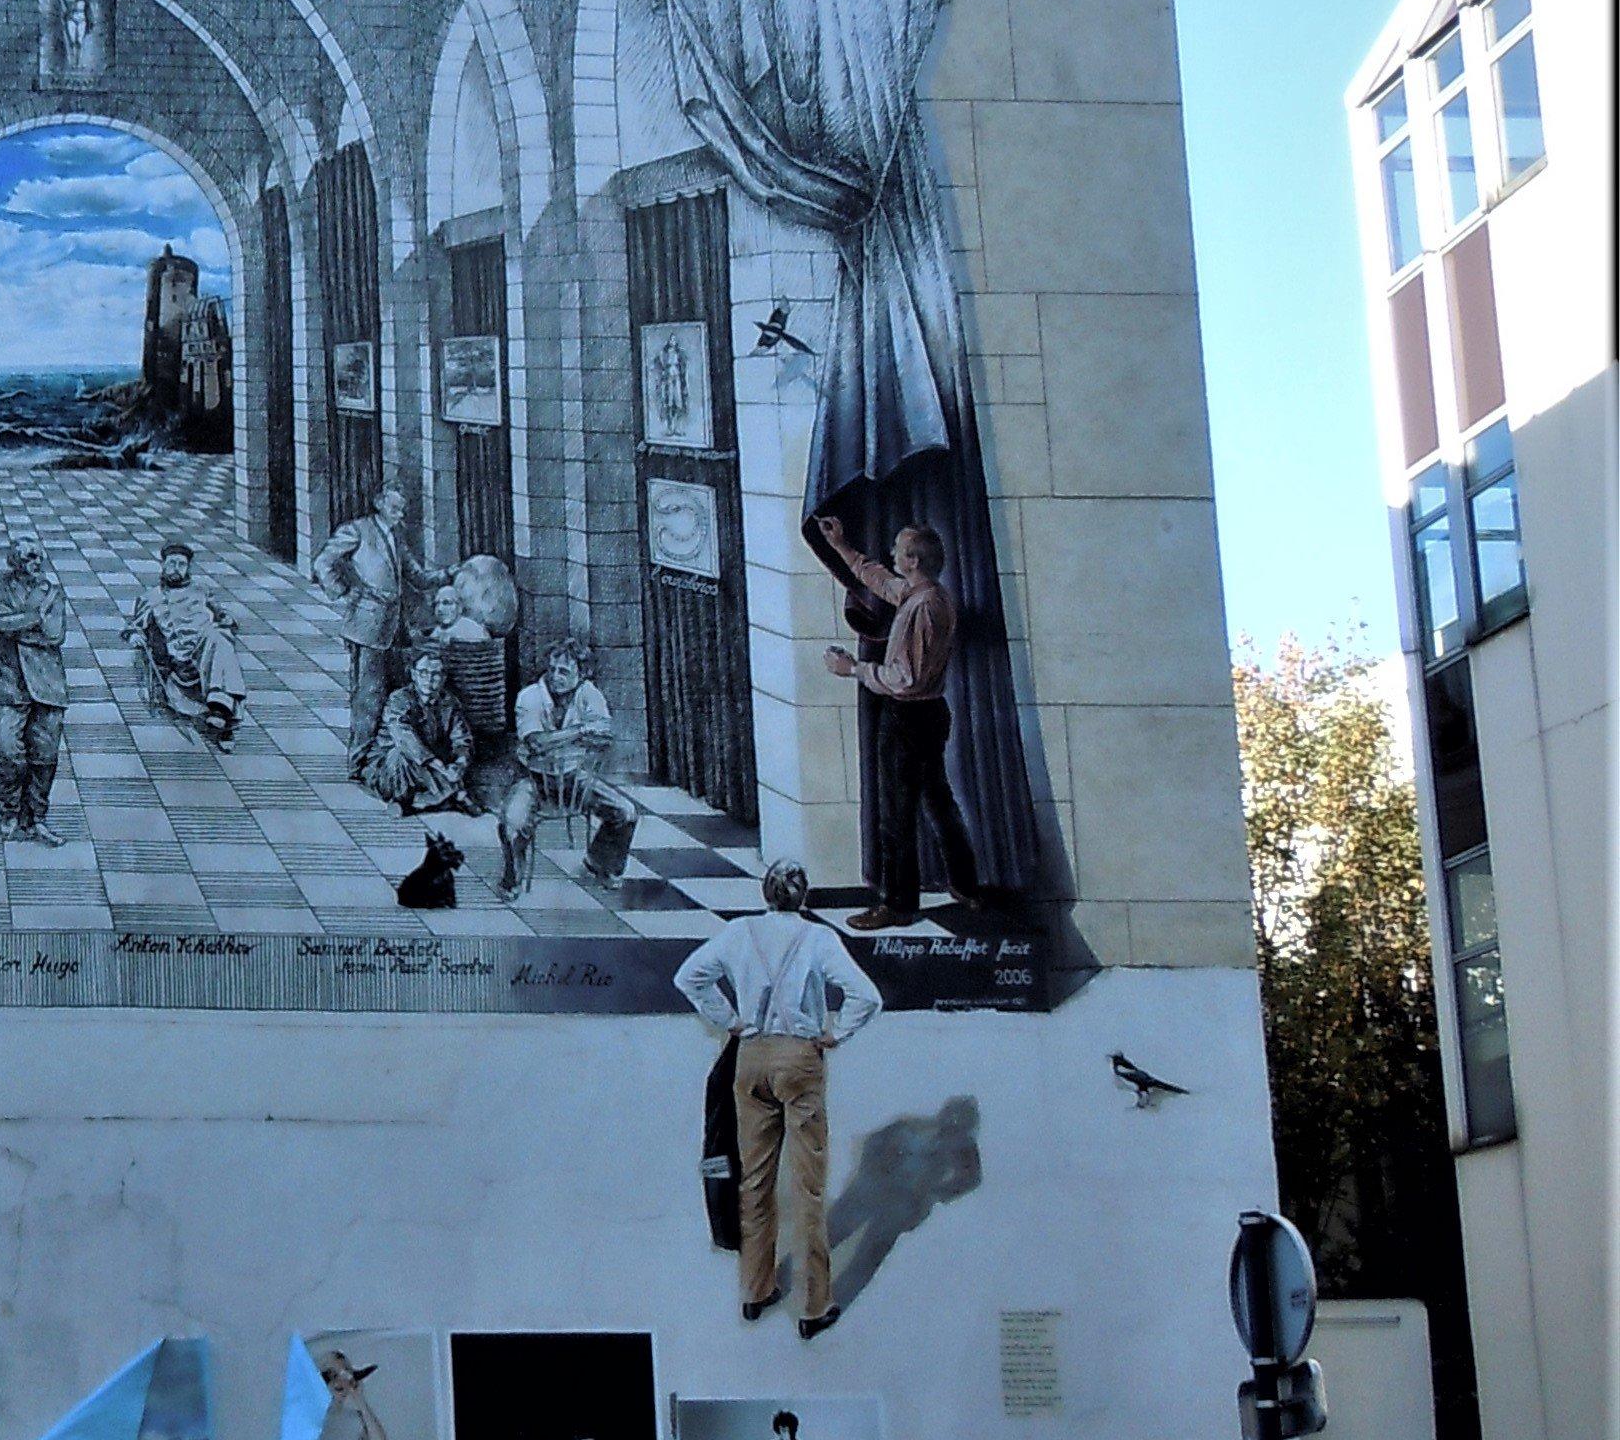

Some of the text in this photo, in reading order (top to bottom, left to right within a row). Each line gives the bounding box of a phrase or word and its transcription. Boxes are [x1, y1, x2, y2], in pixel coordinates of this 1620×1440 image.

[113, 933, 171, 954] Anton
[872, 937, 925, 960] Philippe
[29, 950, 80, 980] Hugo
[994, 967, 1033, 985] 2006
